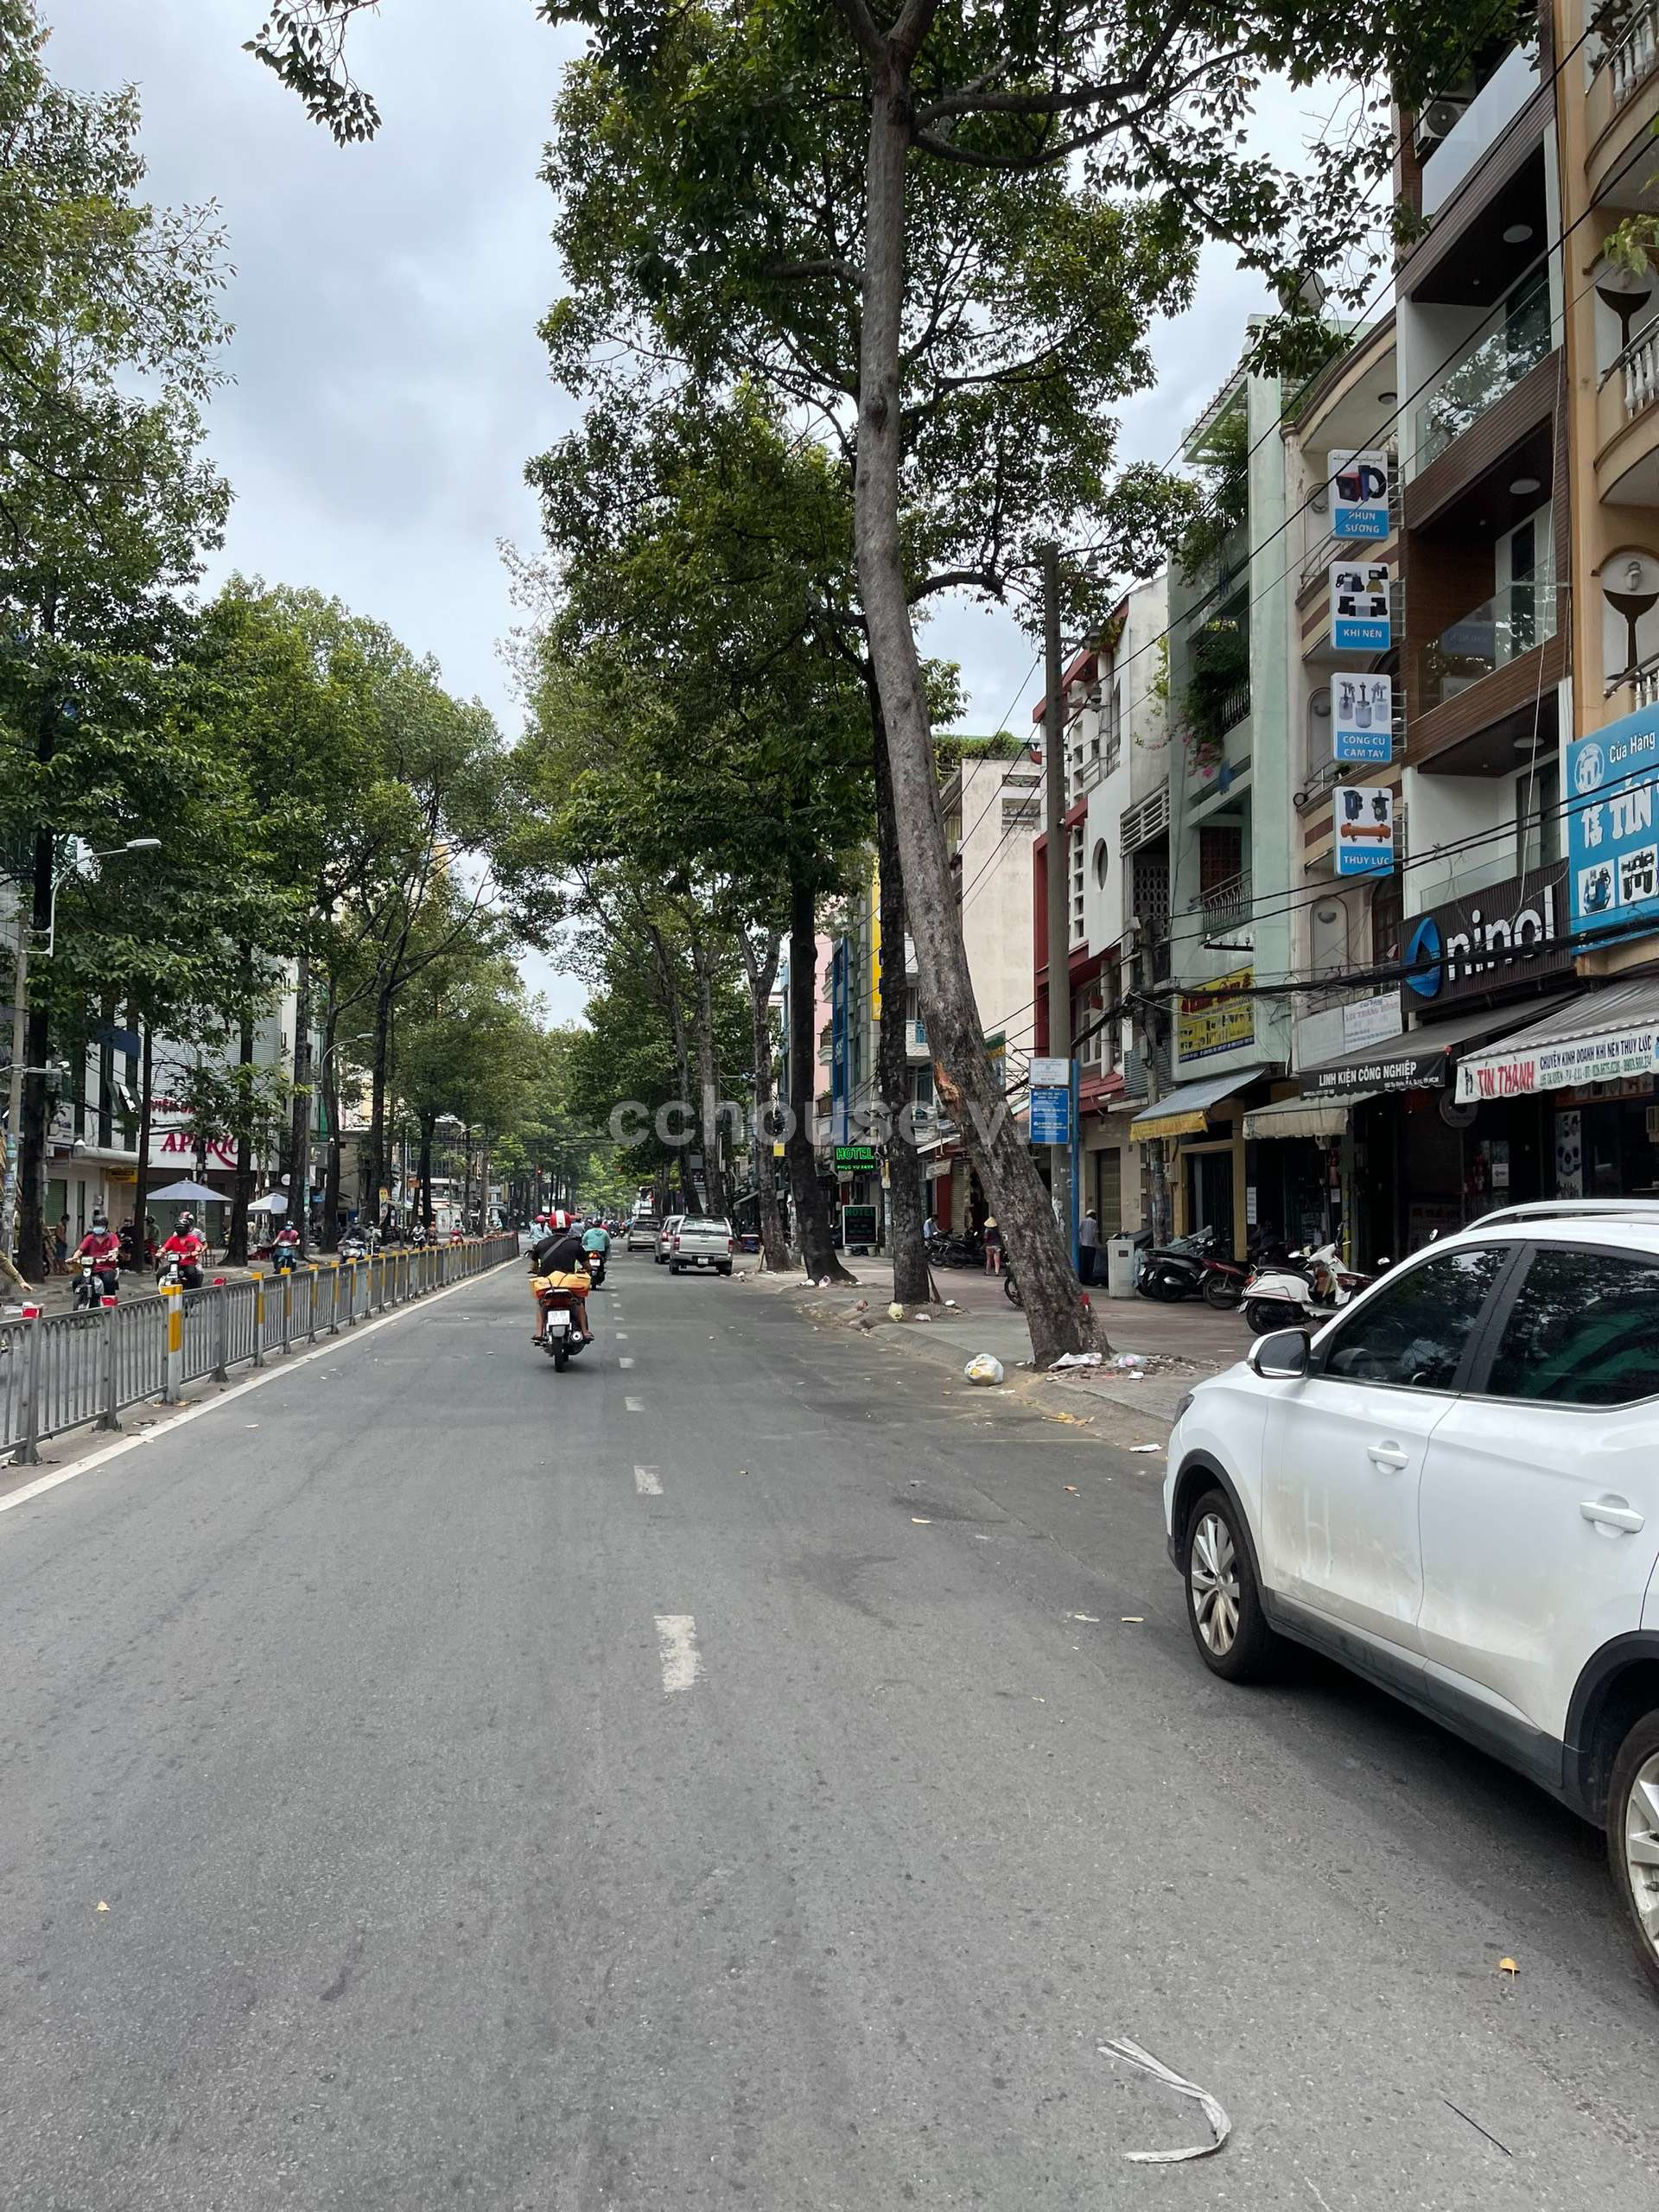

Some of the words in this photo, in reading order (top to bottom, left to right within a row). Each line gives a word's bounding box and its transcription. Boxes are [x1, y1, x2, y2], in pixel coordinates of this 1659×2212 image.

[1630, 731, 1656, 754] Hàng
[1319, 1073, 1336, 1087] LINH
[1338, 1067, 1357, 1087] KIỆN
[1357, 1065, 1382, 1082] CÔNG
[836, 1147, 874, 1160] HOTEL
[845, 1207, 874, 1217] HOTEL
